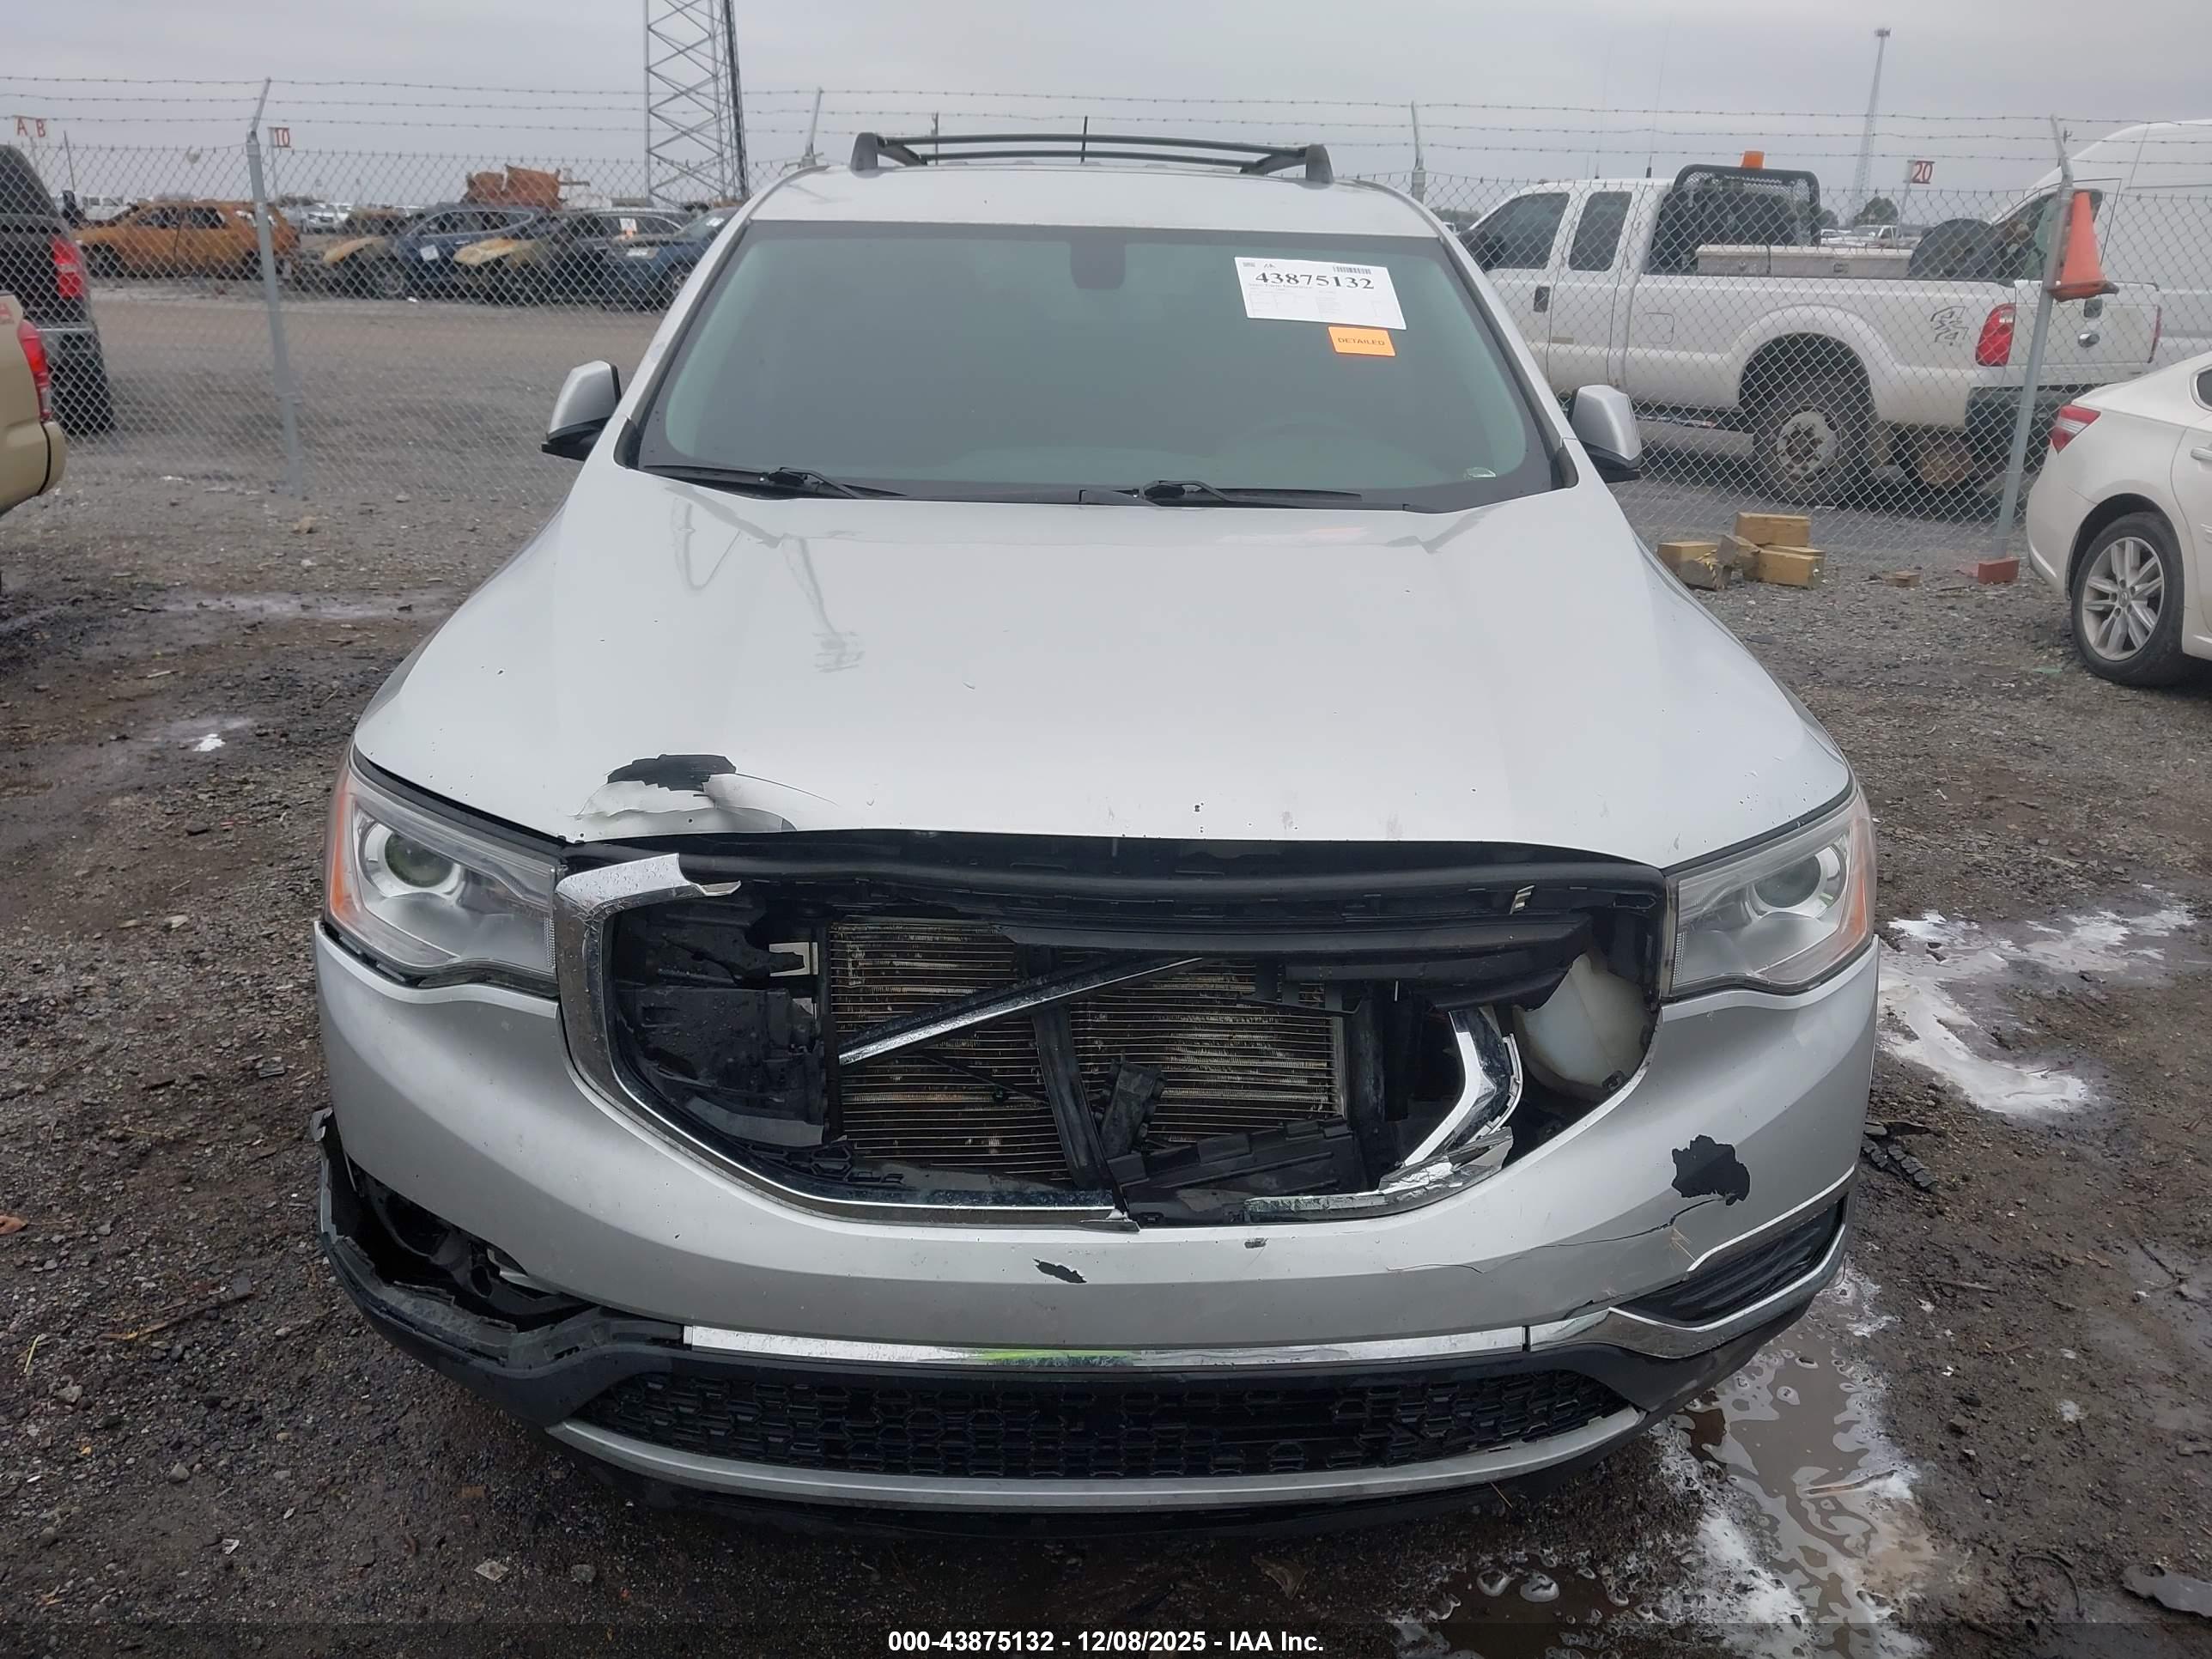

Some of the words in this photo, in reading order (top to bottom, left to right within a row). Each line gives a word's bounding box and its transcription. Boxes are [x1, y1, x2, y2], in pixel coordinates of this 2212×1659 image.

[17, 117, 28, 137] A
[35, 118, 46, 138] B
[274, 128, 290, 147] 10
[1911, 161, 1933, 183] 20
[1255, 271, 1375, 290] 43875132
[1337, 337, 1386, 346] DETAILED
